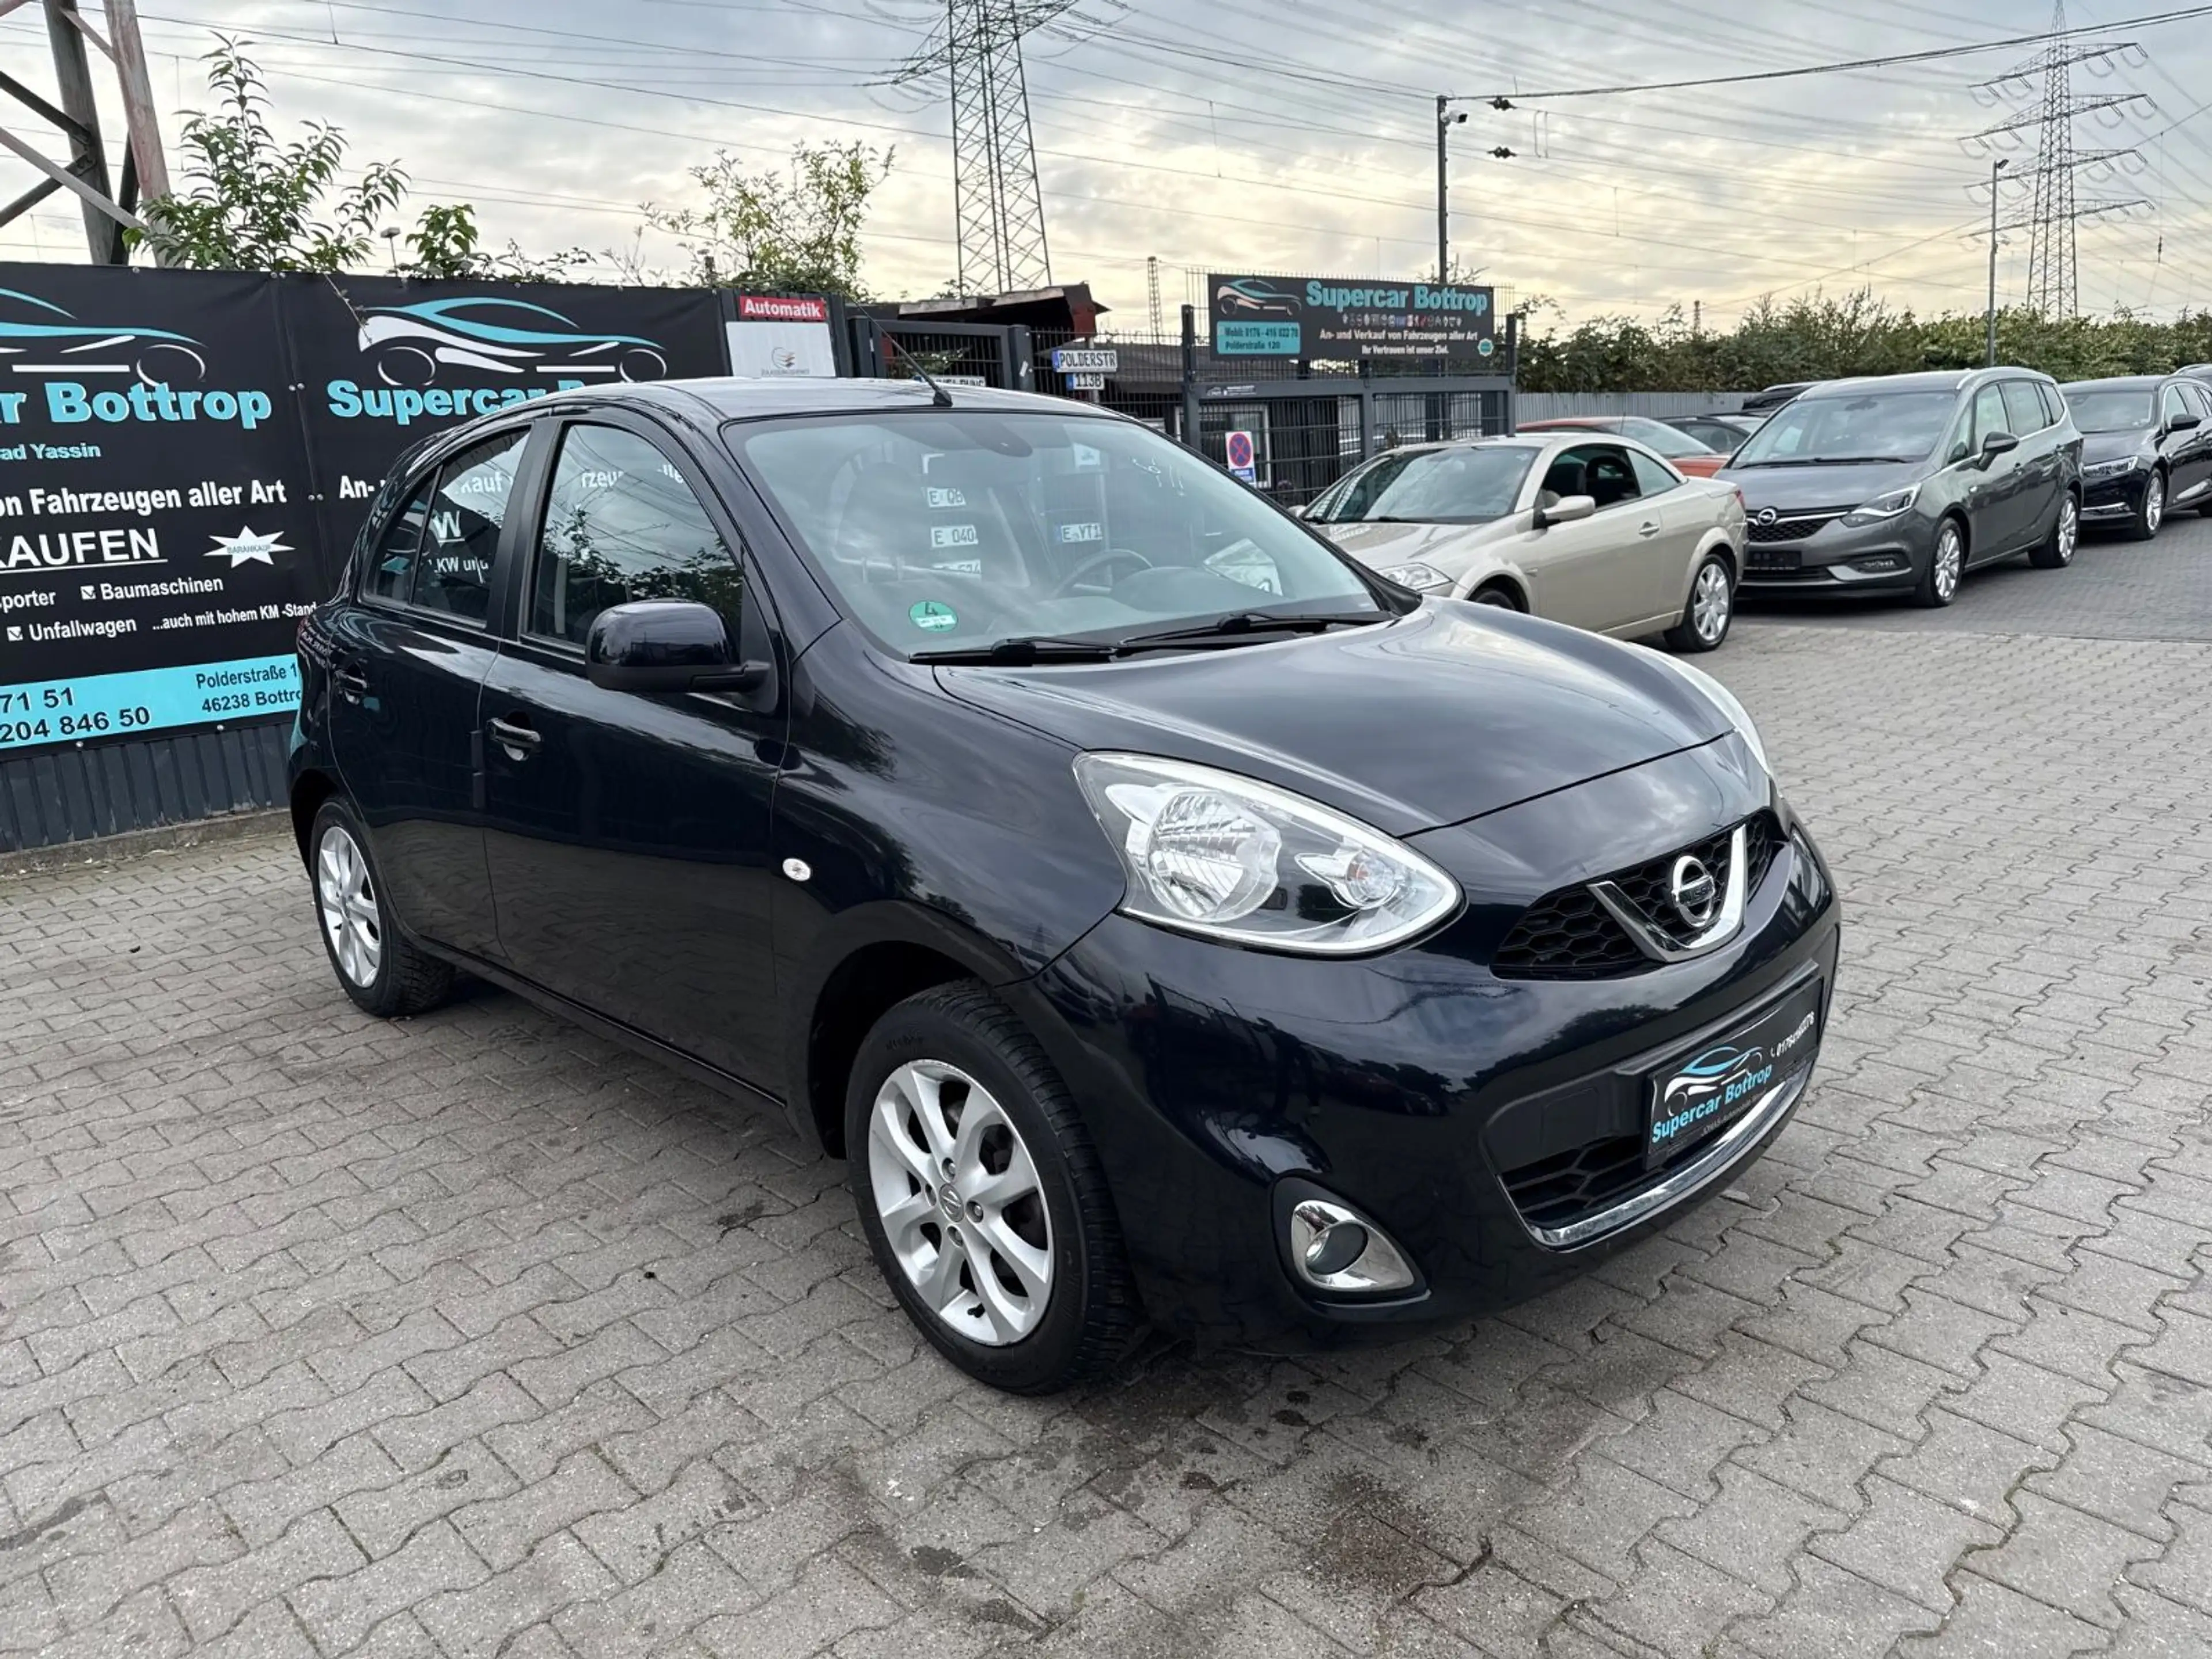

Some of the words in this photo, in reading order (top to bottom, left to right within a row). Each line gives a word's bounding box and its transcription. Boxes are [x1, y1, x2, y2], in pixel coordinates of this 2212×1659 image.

[745, 298, 821, 318] Automatik
[1306, 280, 1409, 313] Supercar
[1414, 285, 1488, 316] Bottrop
[1336, 329, 1351, 340] und
[1354, 329, 1385, 340] Verkauf
[1388, 331, 1402, 340] von
[1403, 329, 1448, 343] Fahrzeugen
[1449, 331, 1465, 341] aller
[1467, 331, 1478, 341] Art
[1060, 351, 1116, 368] POLDERSTR
[1372, 344, 1405, 355] Vertrauen
[45, 382, 272, 429] Bottrop
[29, 442, 101, 460] Yassin
[29, 487, 183, 517] Fahrzeugen
[188, 480, 243, 507] aller
[251, 479, 287, 504] Art
[339, 475, 376, 499] An-
[0, 589, 56, 613] porter
[100, 577, 224, 600] Baumaschinen
[925, 602, 938, 616] 4
[29, 618, 138, 641] Unfallwagen
[195, 610, 215, 627] mit
[217, 608, 258, 624] hohem
[259, 604, 280, 620] KM
[196, 664, 287, 690] Polderstraße
[0, 692, 31, 714] 71
[43, 687, 75, 709] 51
[202, 693, 251, 713] 46238
[0, 719, 51, 743] 204
[59, 711, 110, 736] 846
[119, 706, 151, 733] 50
[1652, 1094, 1722, 1143] Supercar
[1724, 1063, 1773, 1105] Bottrop
